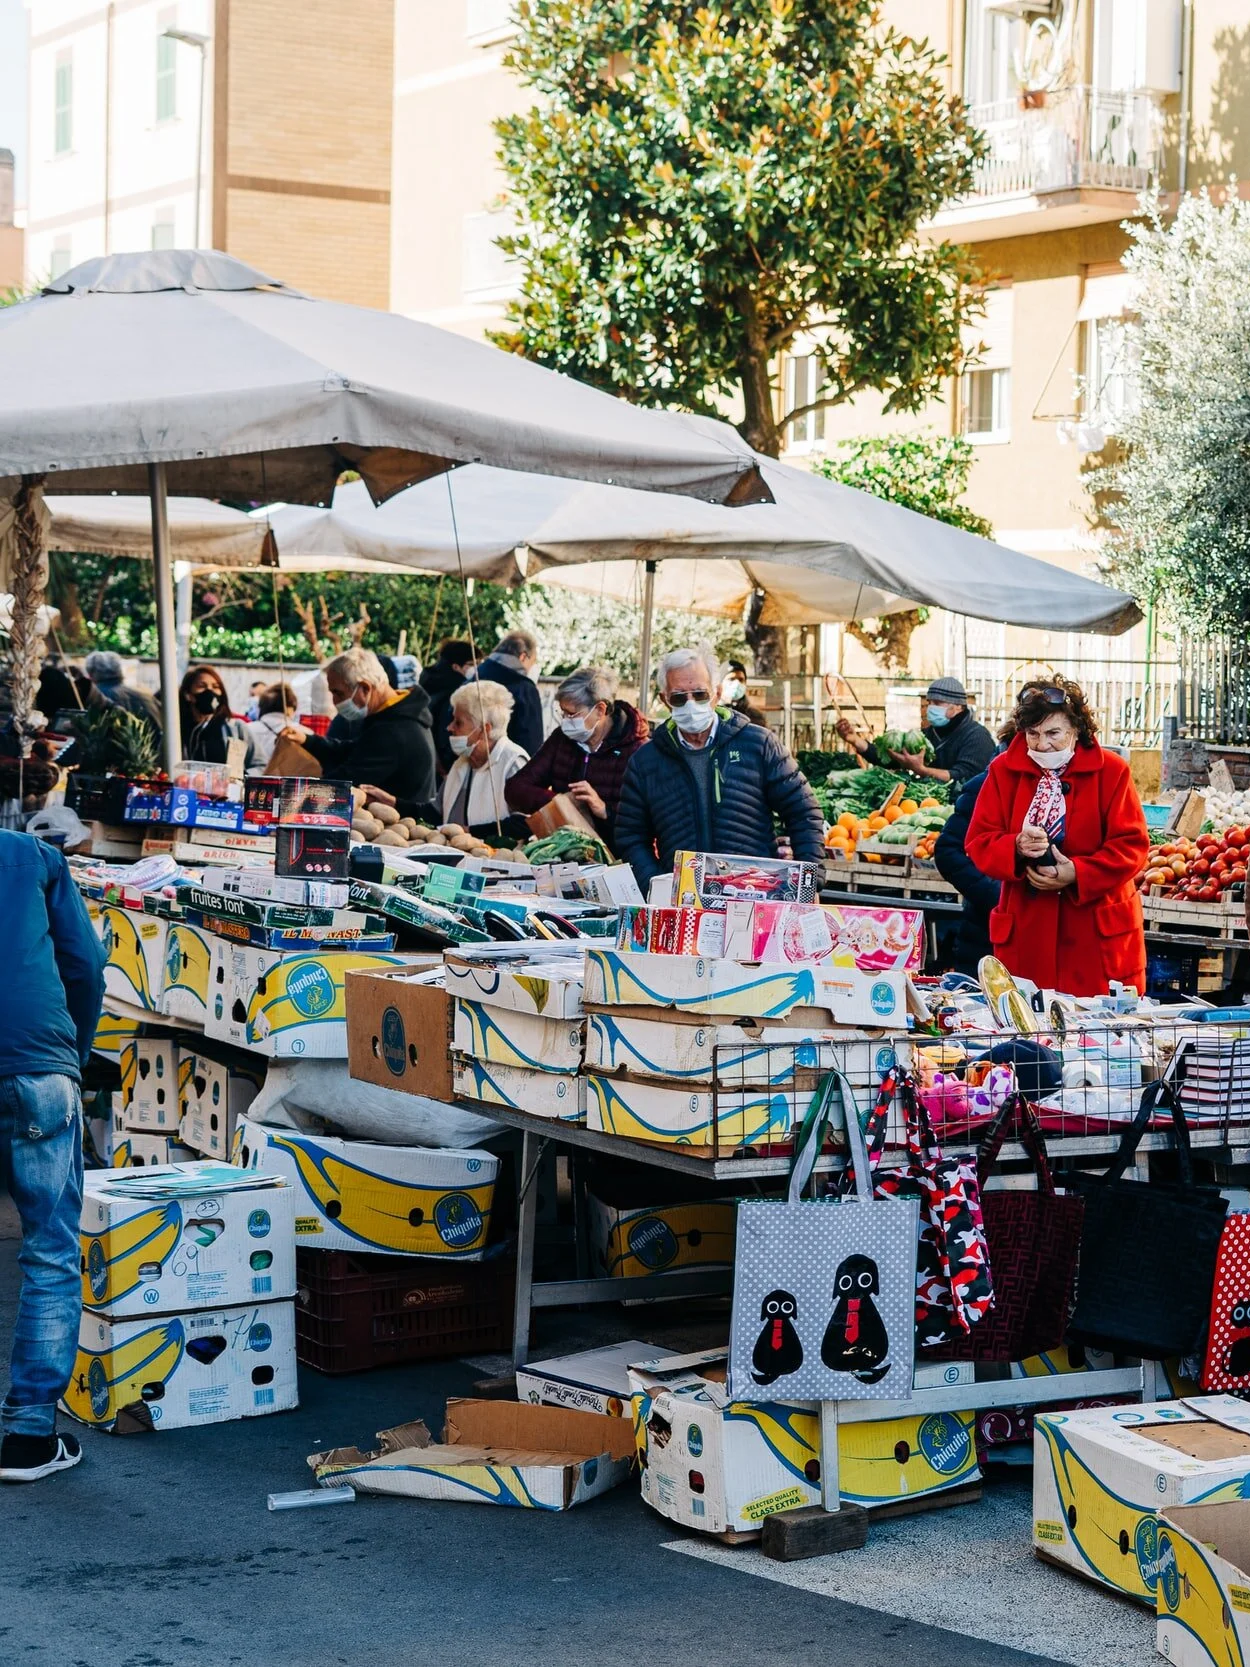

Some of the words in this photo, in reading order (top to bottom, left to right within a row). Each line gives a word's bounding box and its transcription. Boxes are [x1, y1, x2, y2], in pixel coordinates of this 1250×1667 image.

[190, 888, 222, 909] fruites
[224, 897, 245, 915] font
[349, 881, 371, 899] font
[287, 967, 328, 995] Chiquita
[440, 1215, 482, 1242] Chiquita
[630, 1221, 668, 1251] Chiquita
[172, 1243, 200, 1277] 69
[930, 1429, 970, 1471] Chiquita
[745, 1496, 774, 1513] SELECTED
[774, 1488, 799, 1504] QUALITY
[750, 1506, 775, 1520] CLASS
[775, 1495, 801, 1510] EXTRA
